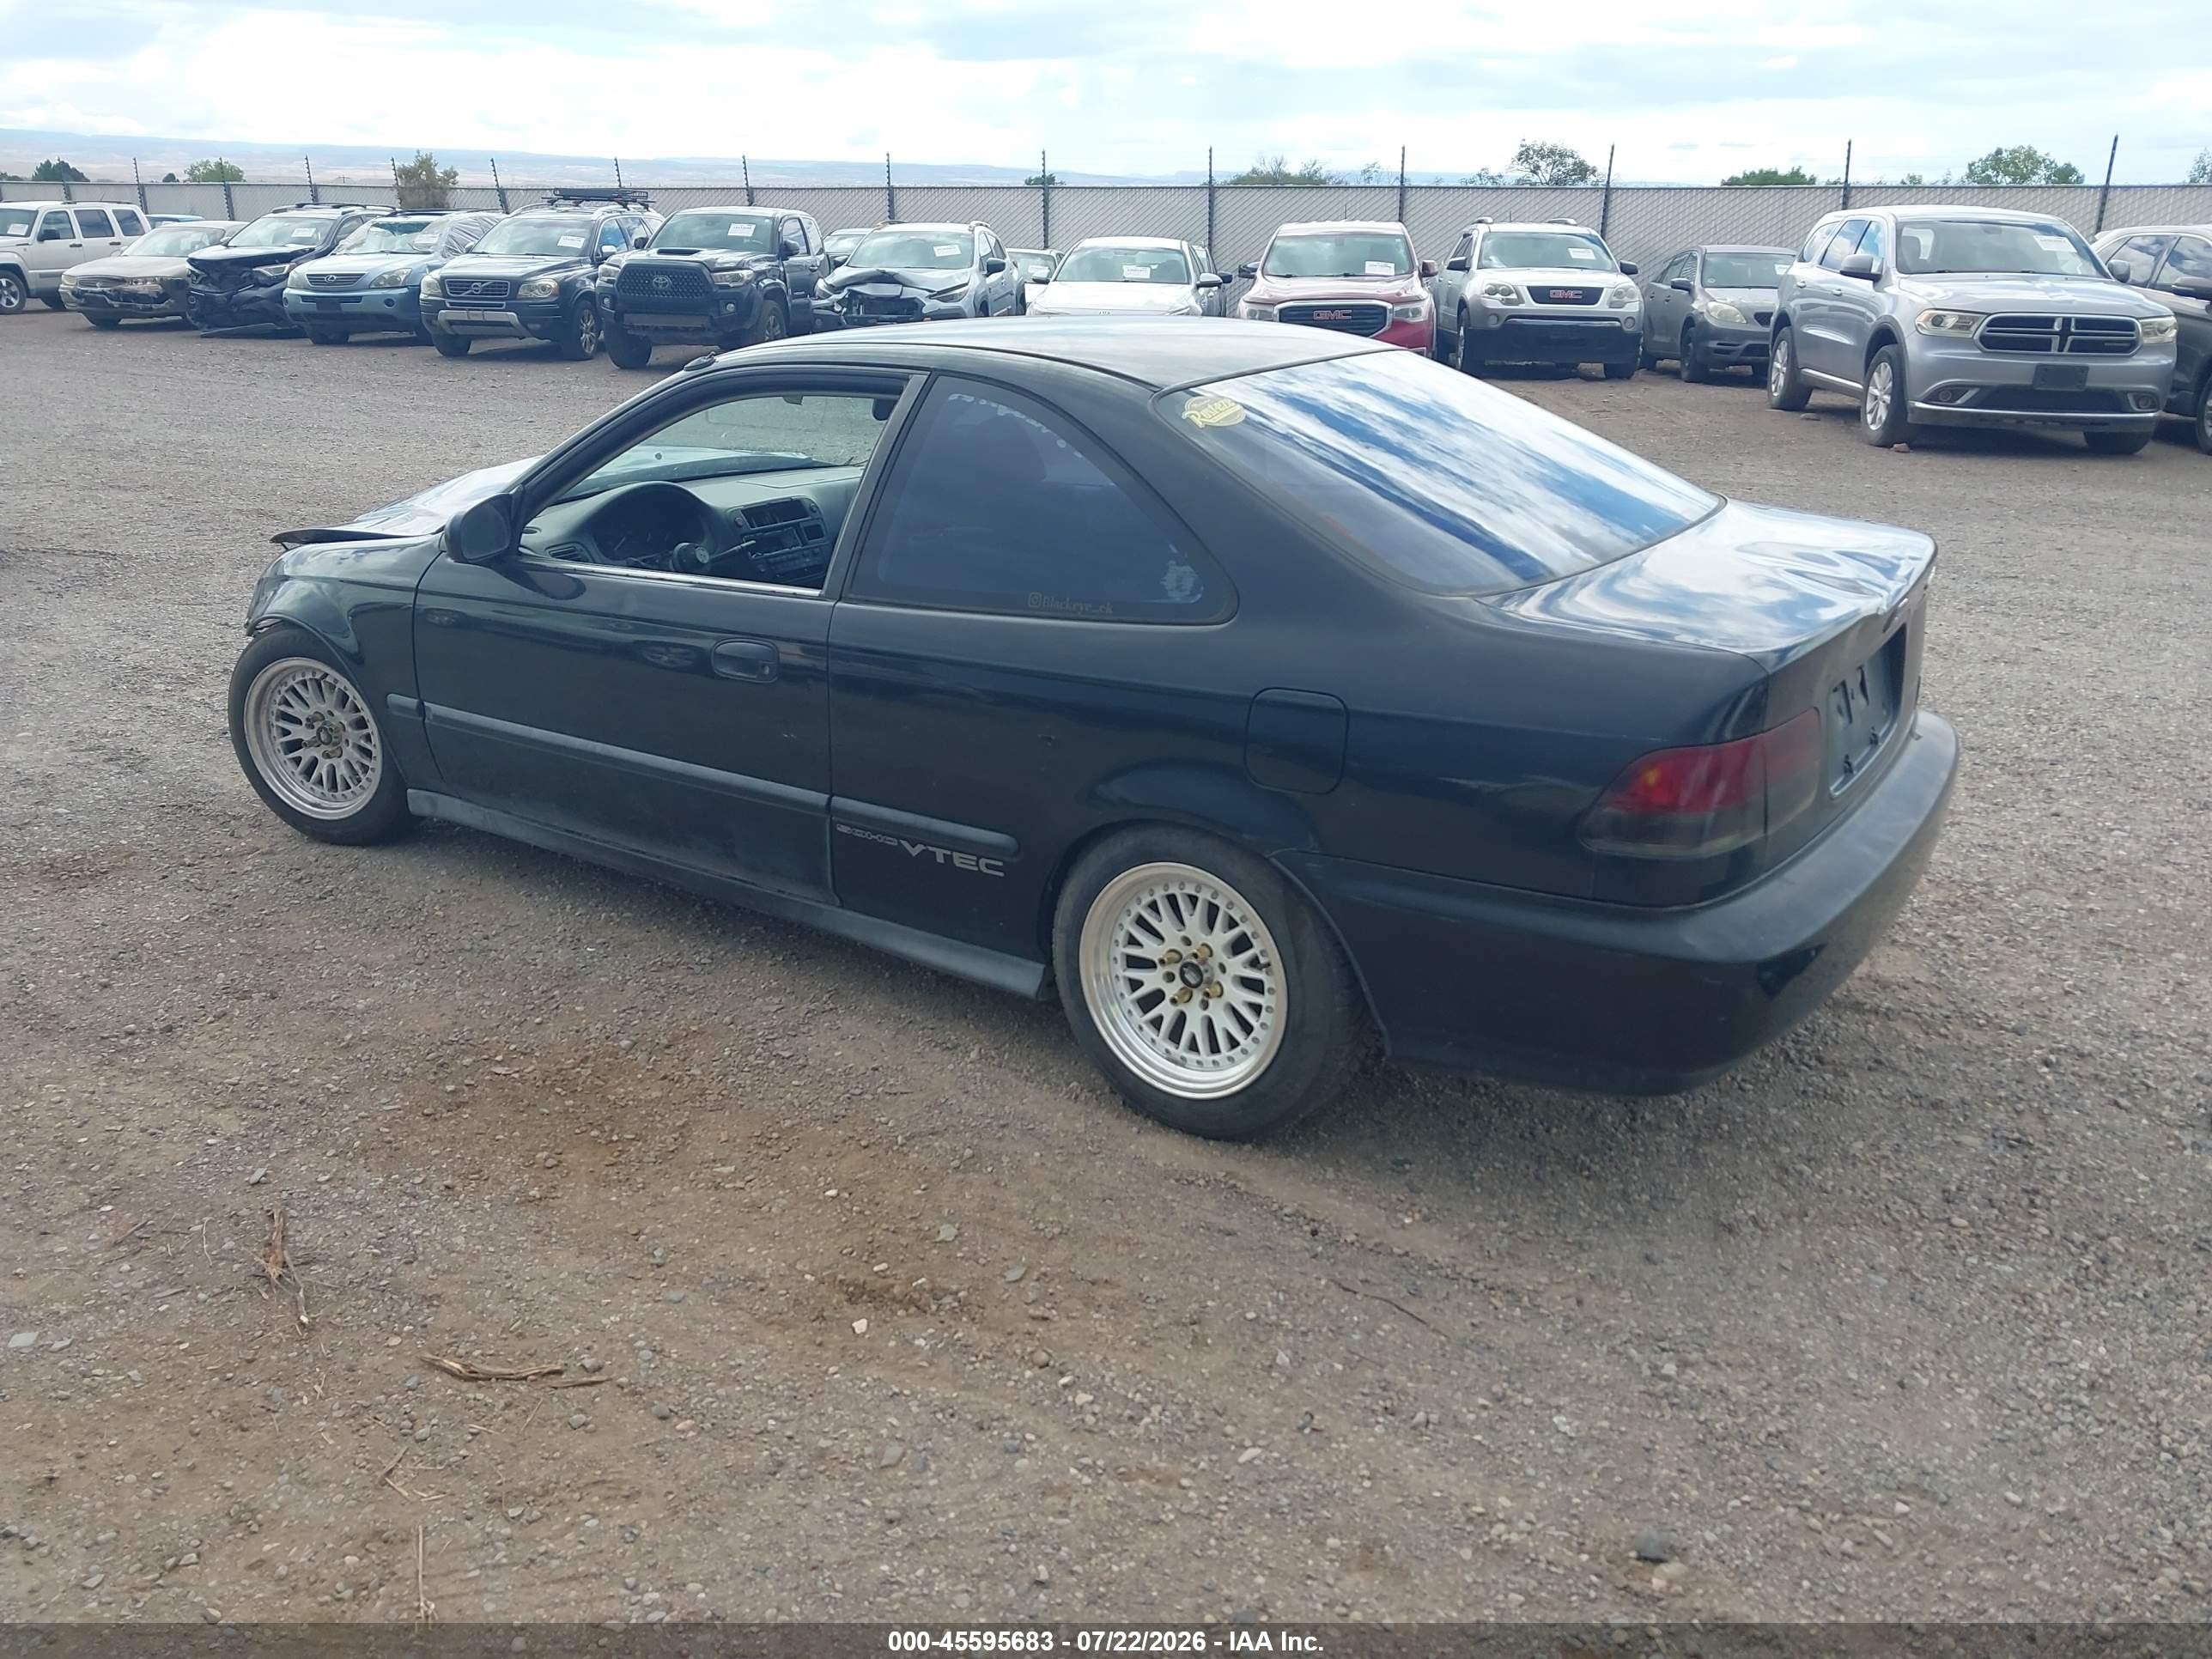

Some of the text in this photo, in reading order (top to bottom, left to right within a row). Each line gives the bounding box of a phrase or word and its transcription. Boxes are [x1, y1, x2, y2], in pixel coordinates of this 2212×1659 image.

[1549, 289, 1583, 300] GMC
[1313, 309, 1352, 320] GMC
[899, 839, 1005, 878] VTEC
